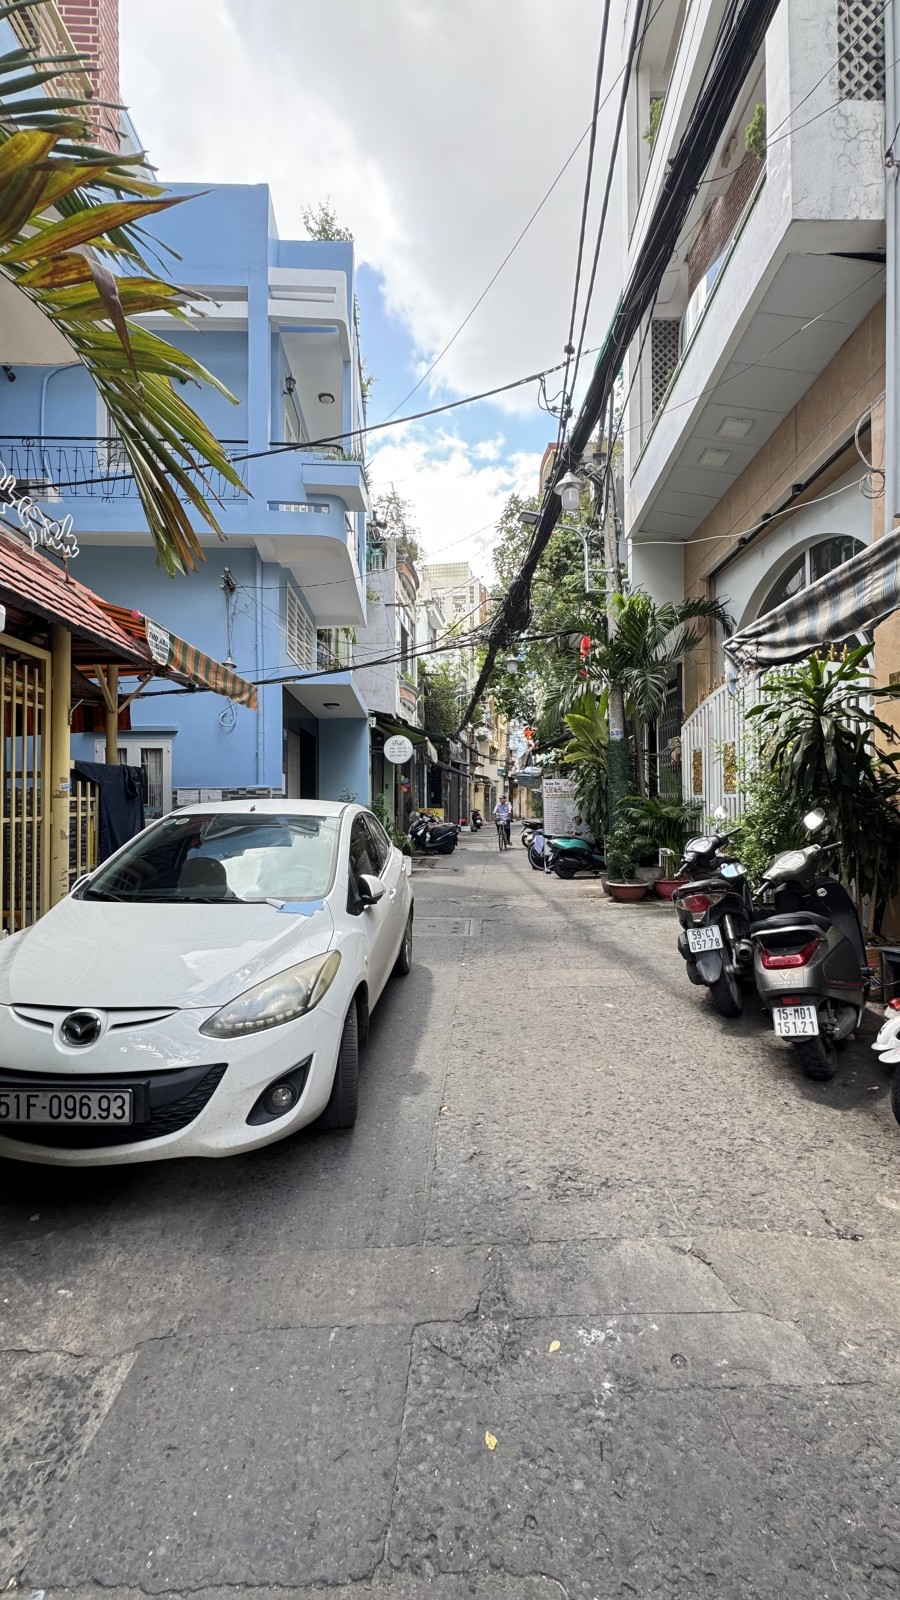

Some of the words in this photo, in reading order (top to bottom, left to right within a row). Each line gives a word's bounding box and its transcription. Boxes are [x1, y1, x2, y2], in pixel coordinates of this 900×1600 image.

[692, 928, 714, 940] 59-C1
[691, 937, 720, 950] 057.78
[778, 1020, 815, 1034] 151.21
[0, 1094, 126, 1120] 51F-096.93
